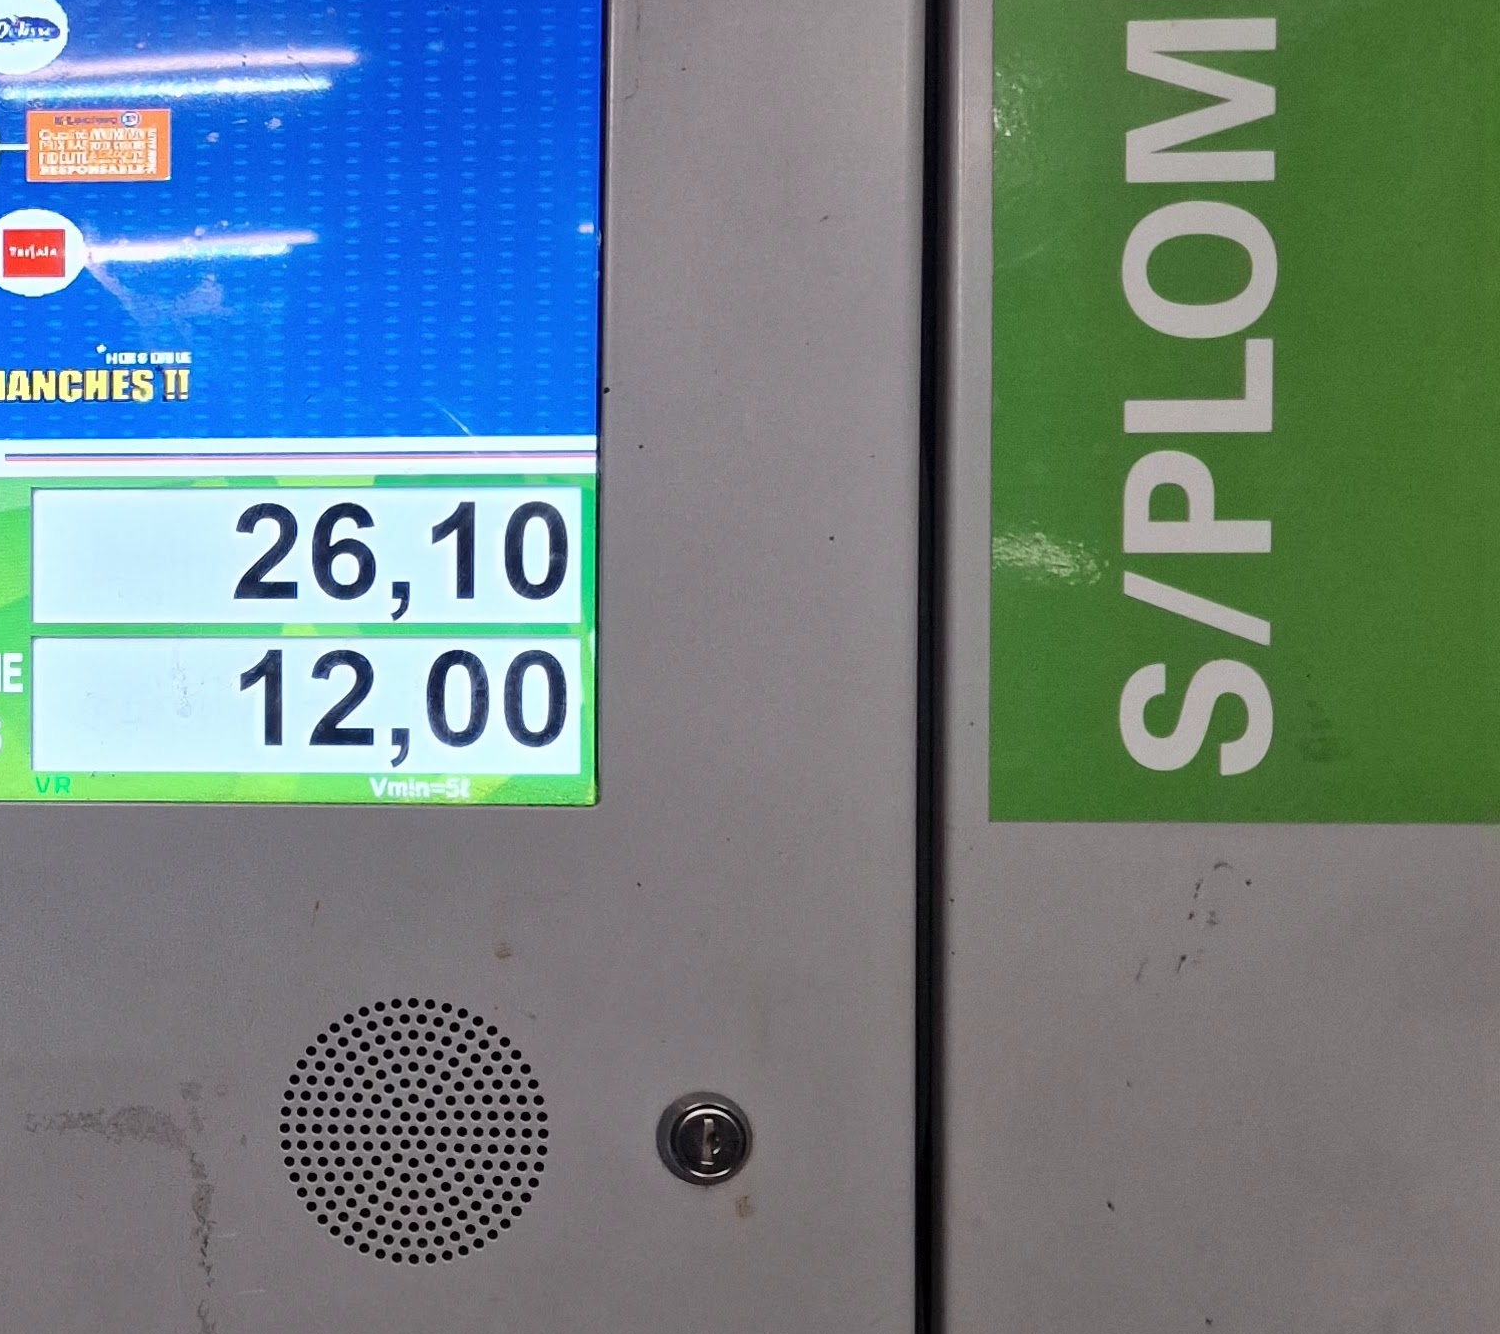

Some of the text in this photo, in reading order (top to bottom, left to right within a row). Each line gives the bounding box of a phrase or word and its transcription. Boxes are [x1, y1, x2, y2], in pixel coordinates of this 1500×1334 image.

[232, 500, 570, 621] 26,10
[238, 647, 568, 768] 12,00
[35, 776, 71, 795] VR
